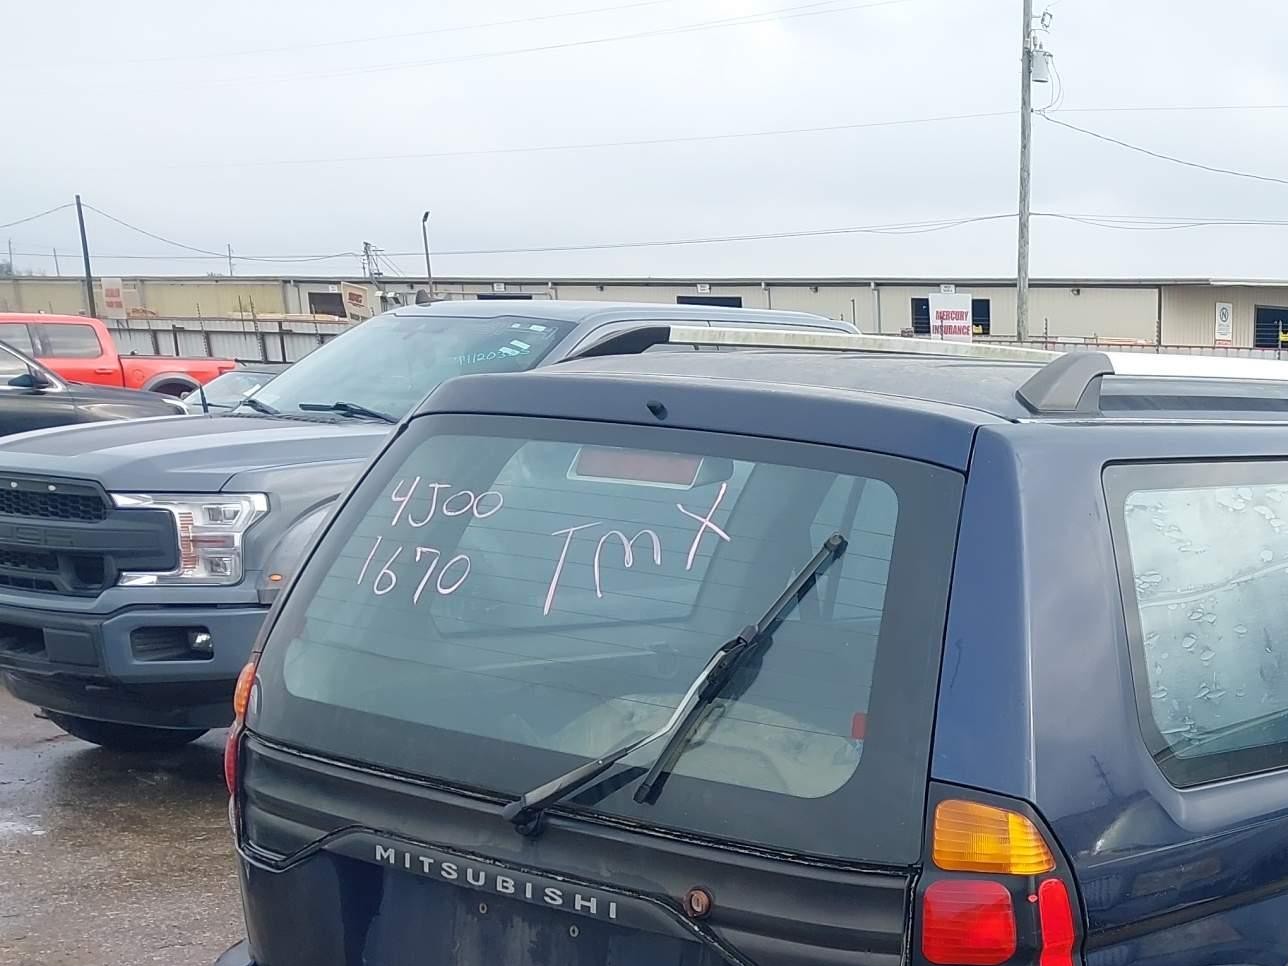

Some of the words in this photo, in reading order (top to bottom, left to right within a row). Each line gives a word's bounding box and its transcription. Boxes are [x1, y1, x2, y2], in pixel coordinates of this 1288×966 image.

[935, 310, 968, 320] MERCURY
[357, 536, 471, 604] 1670
[374, 844, 619, 919] MITSUBISHI
